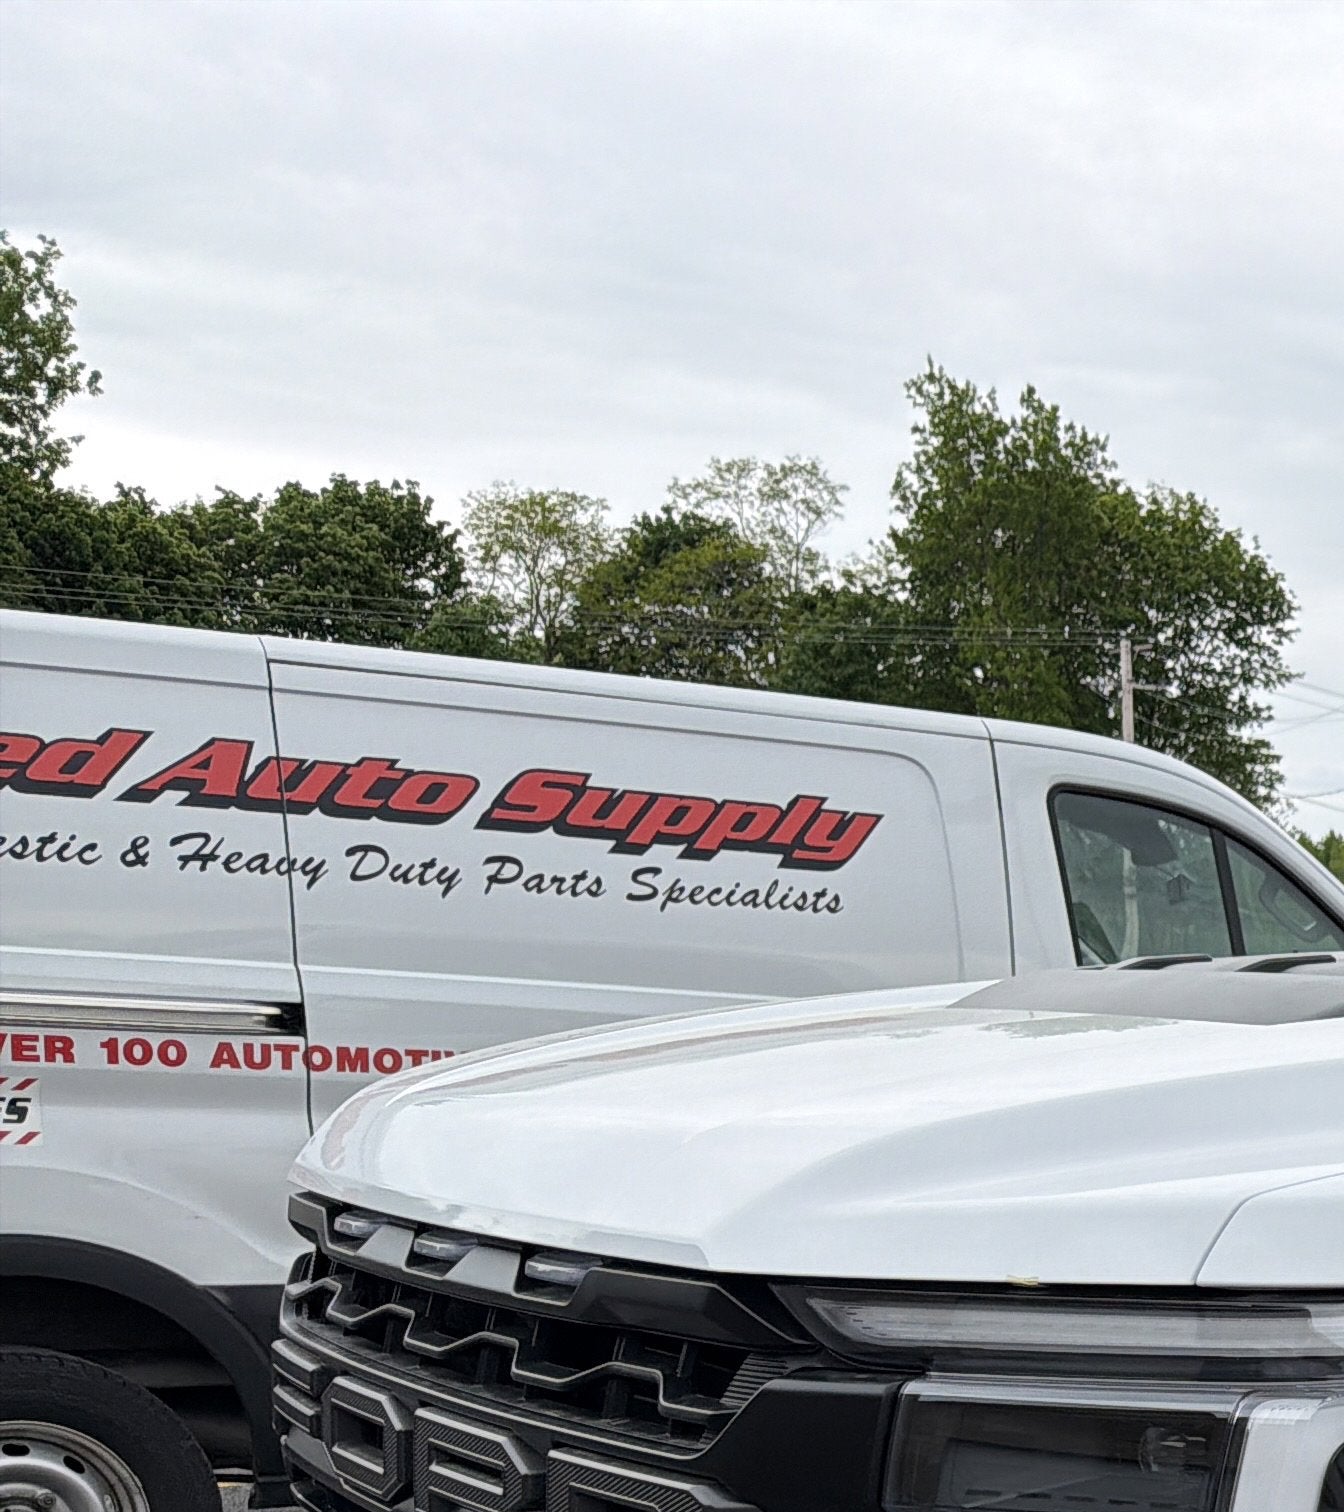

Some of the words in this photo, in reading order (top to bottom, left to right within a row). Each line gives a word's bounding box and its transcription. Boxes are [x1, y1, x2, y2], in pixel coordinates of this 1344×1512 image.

[112, 736, 478, 825] Auto
[473, 768, 884, 872] Supply
[119, 835, 150, 868] &
[169, 831, 329, 891] Heavy
[344, 844, 472, 900] Duty
[482, 855, 607, 896] Parts
[625, 866, 844, 913] Specialists
[0, 1033, 75, 1064] ER
[99, 1037, 188, 1067] 100
[208, 1041, 467, 1075] AUTOMOT
